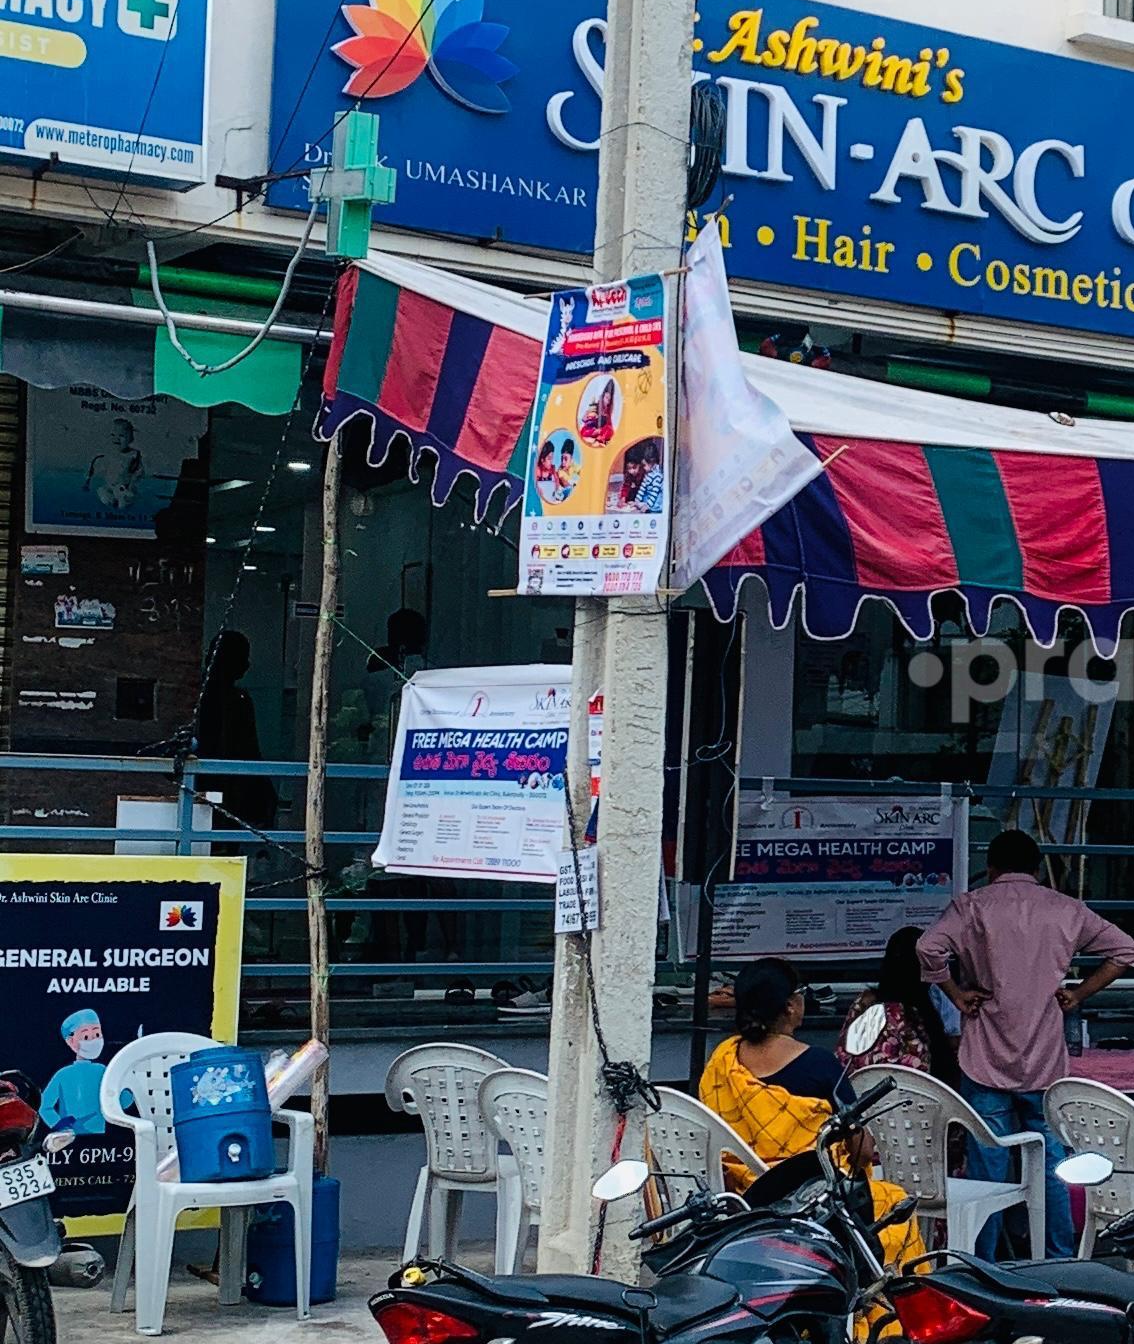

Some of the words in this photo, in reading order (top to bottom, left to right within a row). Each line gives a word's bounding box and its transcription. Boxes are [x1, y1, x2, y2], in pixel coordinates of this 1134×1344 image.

[707, 8, 965, 104] Ashwini's
[36, 124, 194, 164] www.meteropharmacy.com
[406, 159, 588, 208] UMASHANKAR
[792, 215, 895, 273] Hair
[411, 732, 437, 749] FREE
[438, 732, 470, 748] MEGA
[472, 732, 524, 749] HEALTH
[525, 731, 568, 749] CAMP
[912, 812, 940, 825] ARC
[757, 843, 813, 856] MEGA
[818, 842, 882, 856] HEALTH
[887, 842, 936, 855] CAMP
[10, 892, 48, 904] Ashwini
[50, 892, 71, 903] Skin
[73, 893, 89, 903] Arc
[91, 892, 118, 903] Clinic
[103, 948, 209, 967] SURGEON
[47, 977, 150, 993] AVAILABLE
[88, 1175, 112, 1185] CALL
